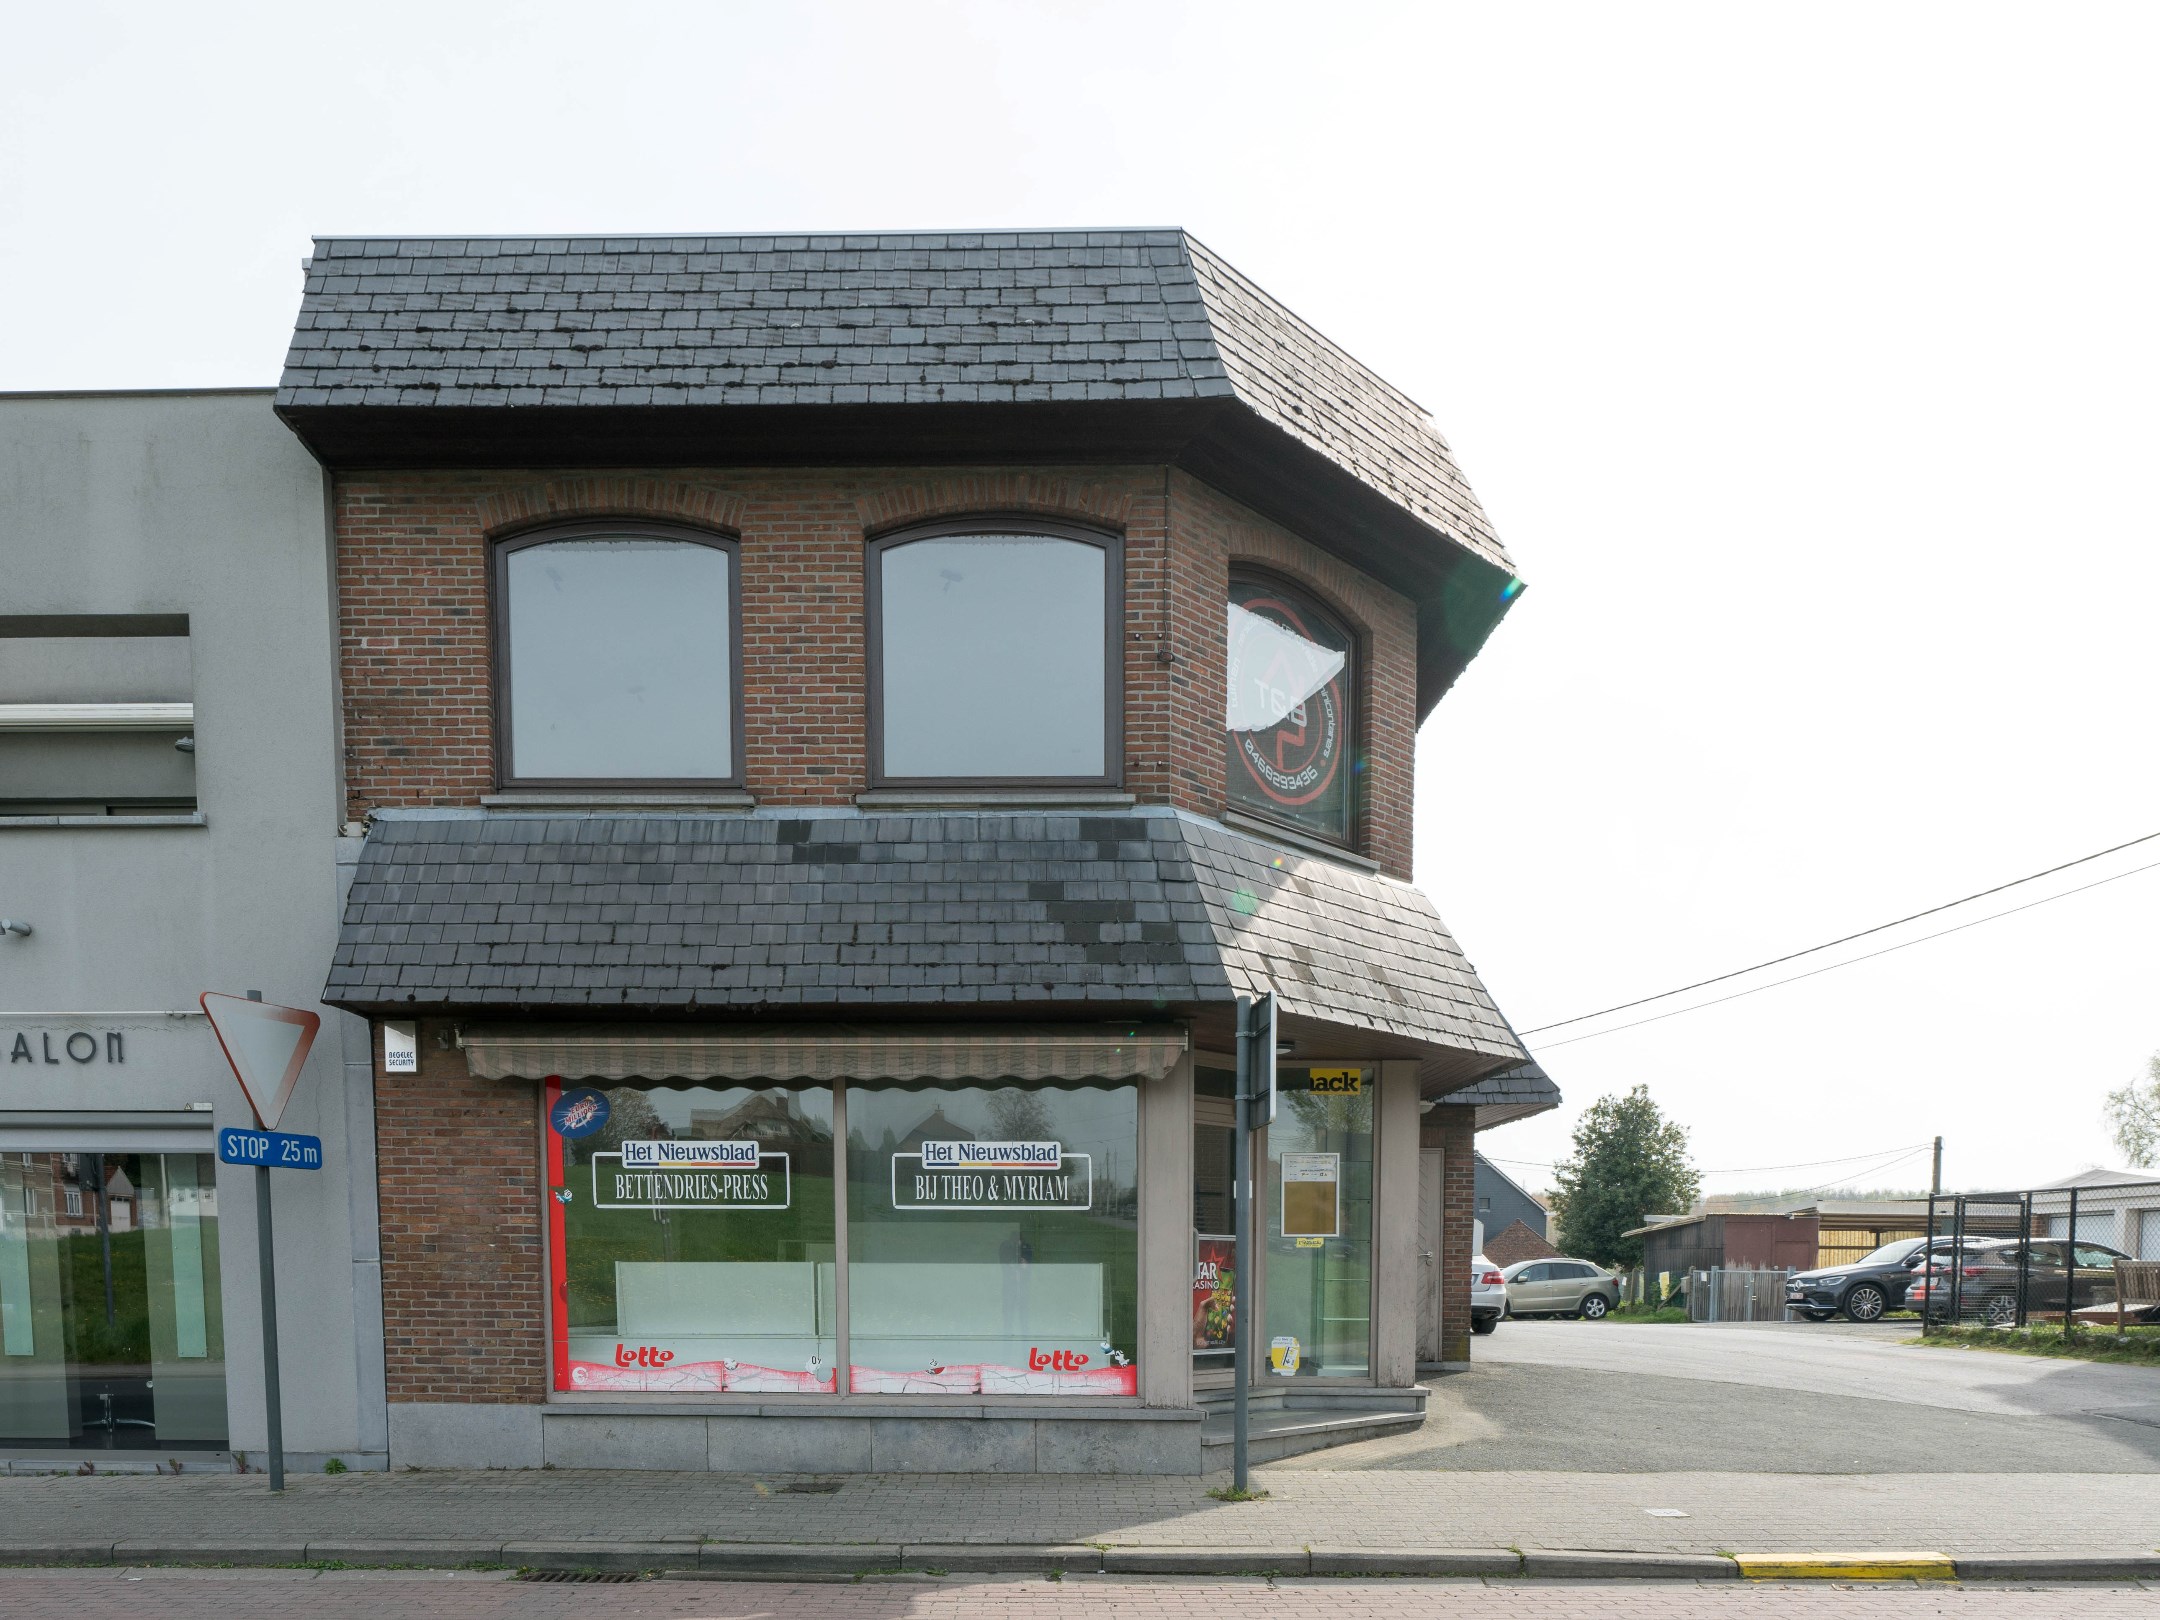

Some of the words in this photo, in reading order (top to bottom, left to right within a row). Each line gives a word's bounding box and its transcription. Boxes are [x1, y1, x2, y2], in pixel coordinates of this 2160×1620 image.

[1245, 738, 1318, 790] 0468293436
[388, 1051, 413, 1059] BEGELEC
[564, 1103, 598, 1125] MILLIONS
[570, 1100, 589, 1114] EURO
[227, 1134, 269, 1159] STOP
[624, 1142, 653, 1161] Het
[657, 1142, 756, 1161] Nieuwsblad
[924, 1143, 953, 1161] Het
[957, 1143, 1058, 1162] Nieuwsblad
[615, 1174, 768, 1200] BETTENDRIES-PRESS
[915, 1175, 938, 1201] BIJ
[940, 1174, 984, 1201] THEO
[987, 1174, 999, 1201] &
[1003, 1174, 1069, 1201] MYRIAM
[1192, 1280, 1220, 1290] ASINO
